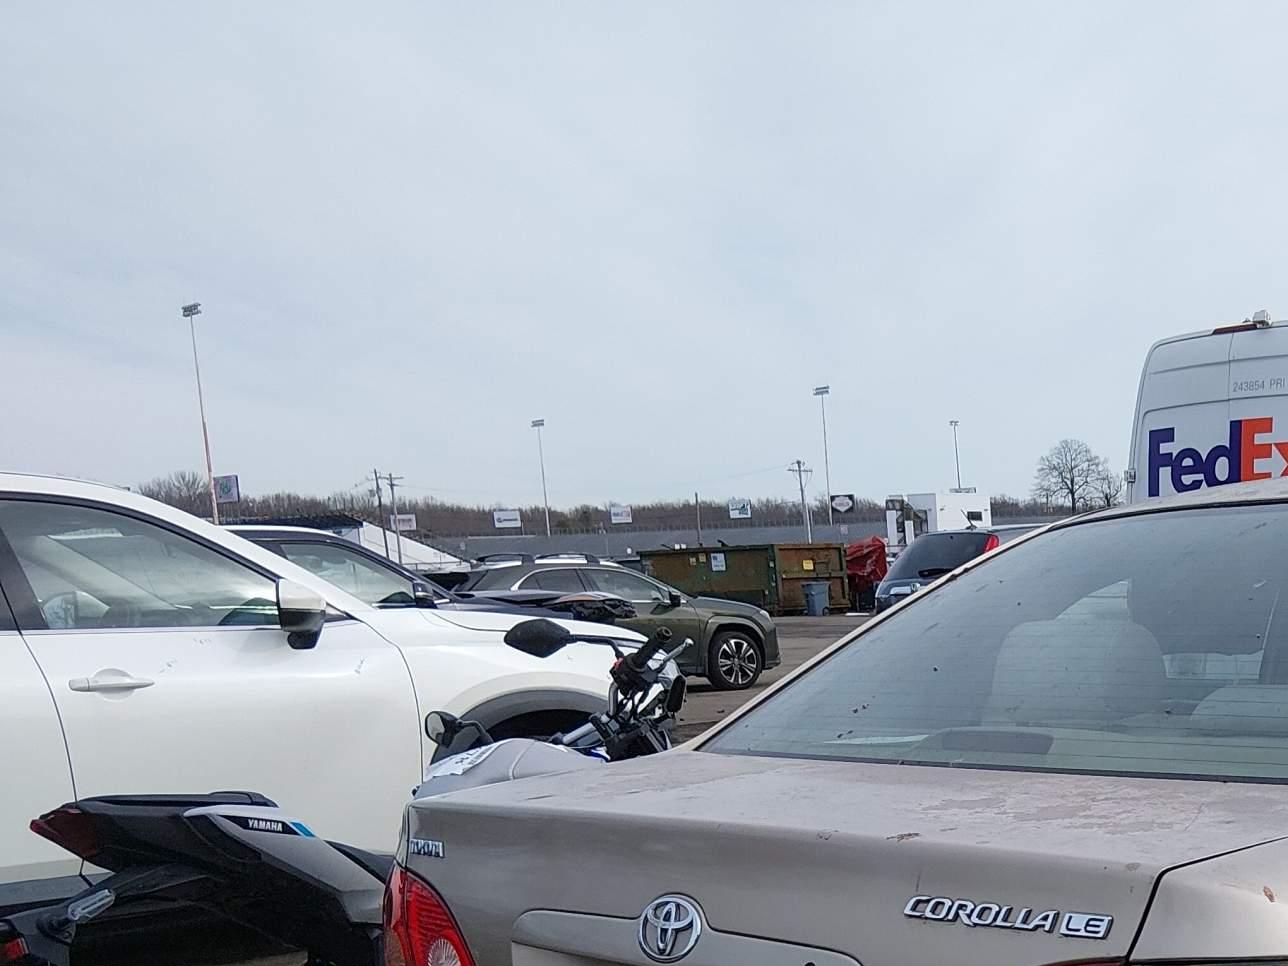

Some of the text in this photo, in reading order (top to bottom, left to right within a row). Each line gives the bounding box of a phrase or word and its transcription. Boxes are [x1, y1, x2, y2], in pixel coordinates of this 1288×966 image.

[1232, 378, 1286, 392] 243854 PRI
[247, 819, 283, 832] YAMAHA
[903, 896, 1109, 937] COROLLA LE
